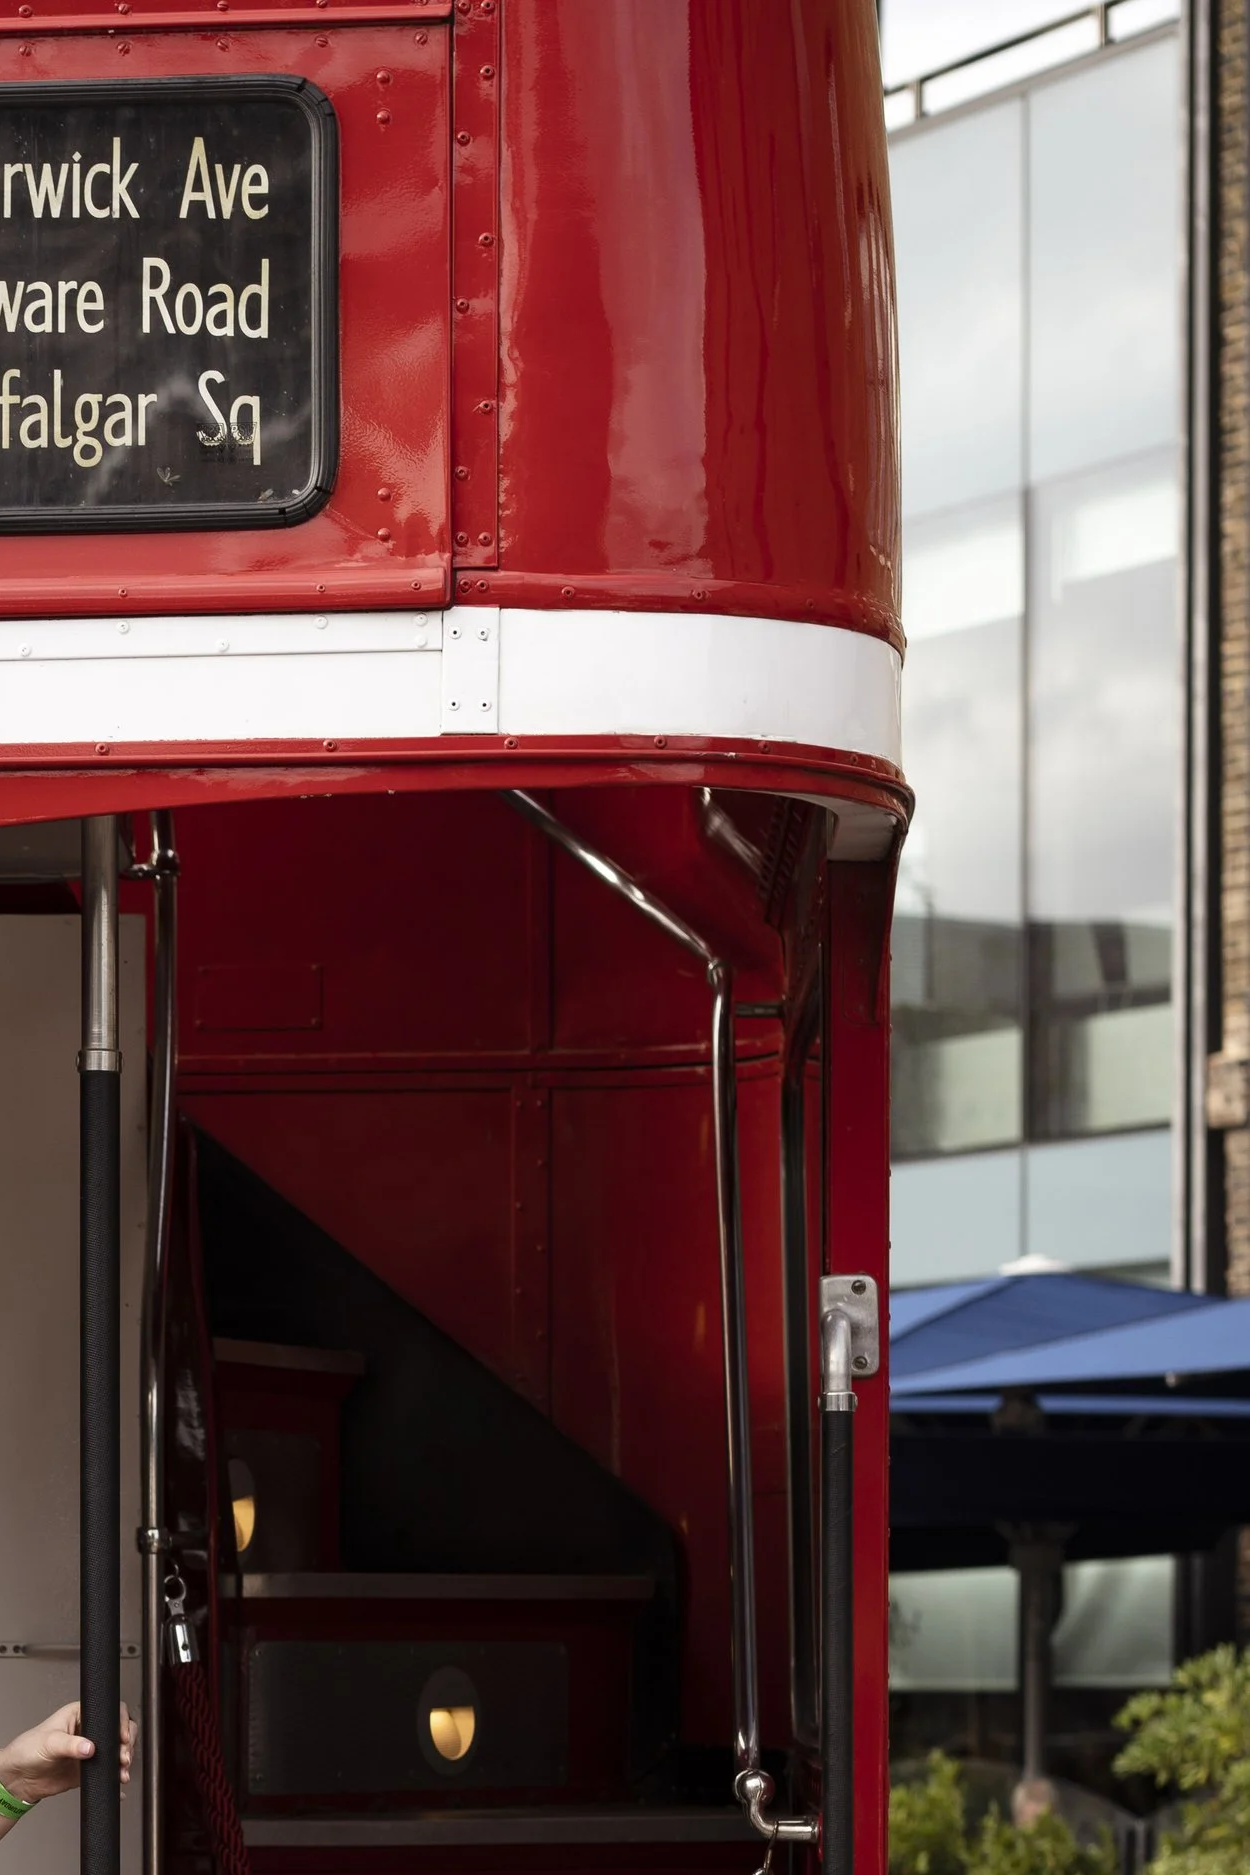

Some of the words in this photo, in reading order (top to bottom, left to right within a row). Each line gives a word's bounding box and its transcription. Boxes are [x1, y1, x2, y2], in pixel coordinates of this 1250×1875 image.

[179, 137, 269, 220] Ave
[142, 258, 270, 339] Road
[197, 370, 262, 466] Sq
